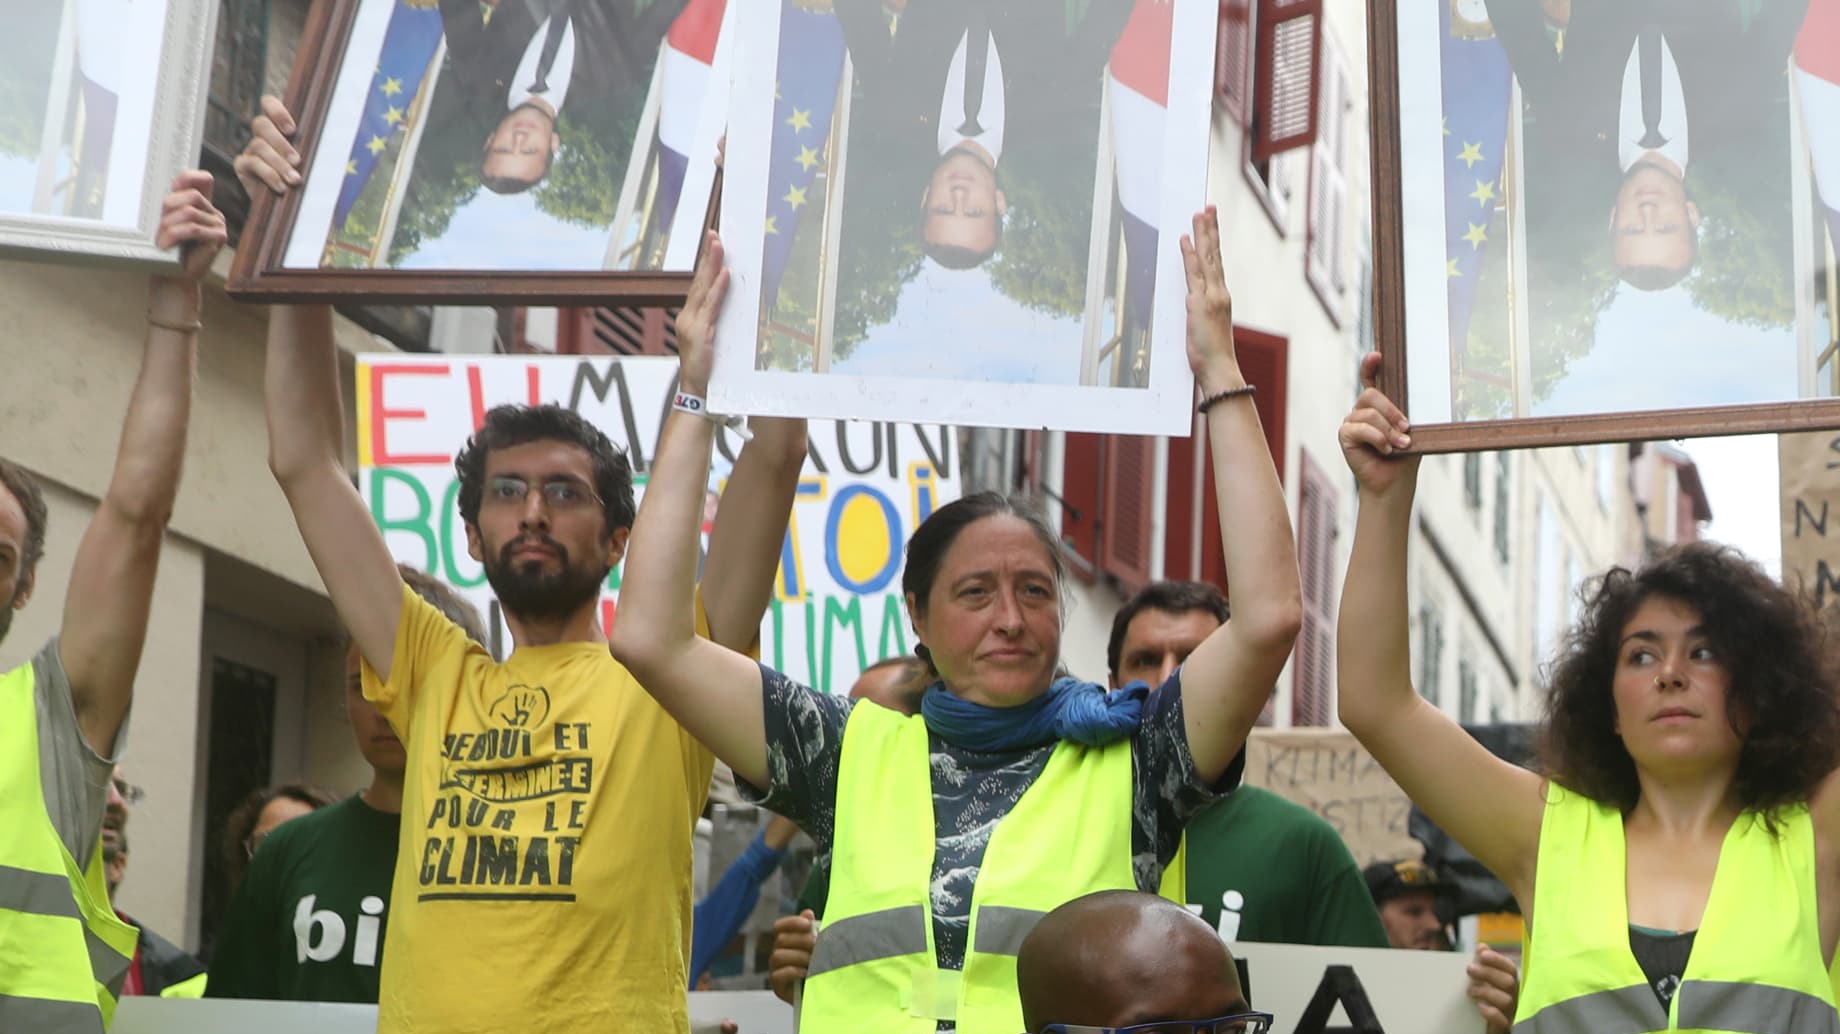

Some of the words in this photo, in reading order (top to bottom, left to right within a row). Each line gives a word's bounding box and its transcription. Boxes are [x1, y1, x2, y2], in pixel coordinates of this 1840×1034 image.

[554, 722, 592, 751] ET
[427, 794, 516, 832] POUR
[544, 800, 587, 833] LE
[419, 835, 582, 887] CLIMAT
